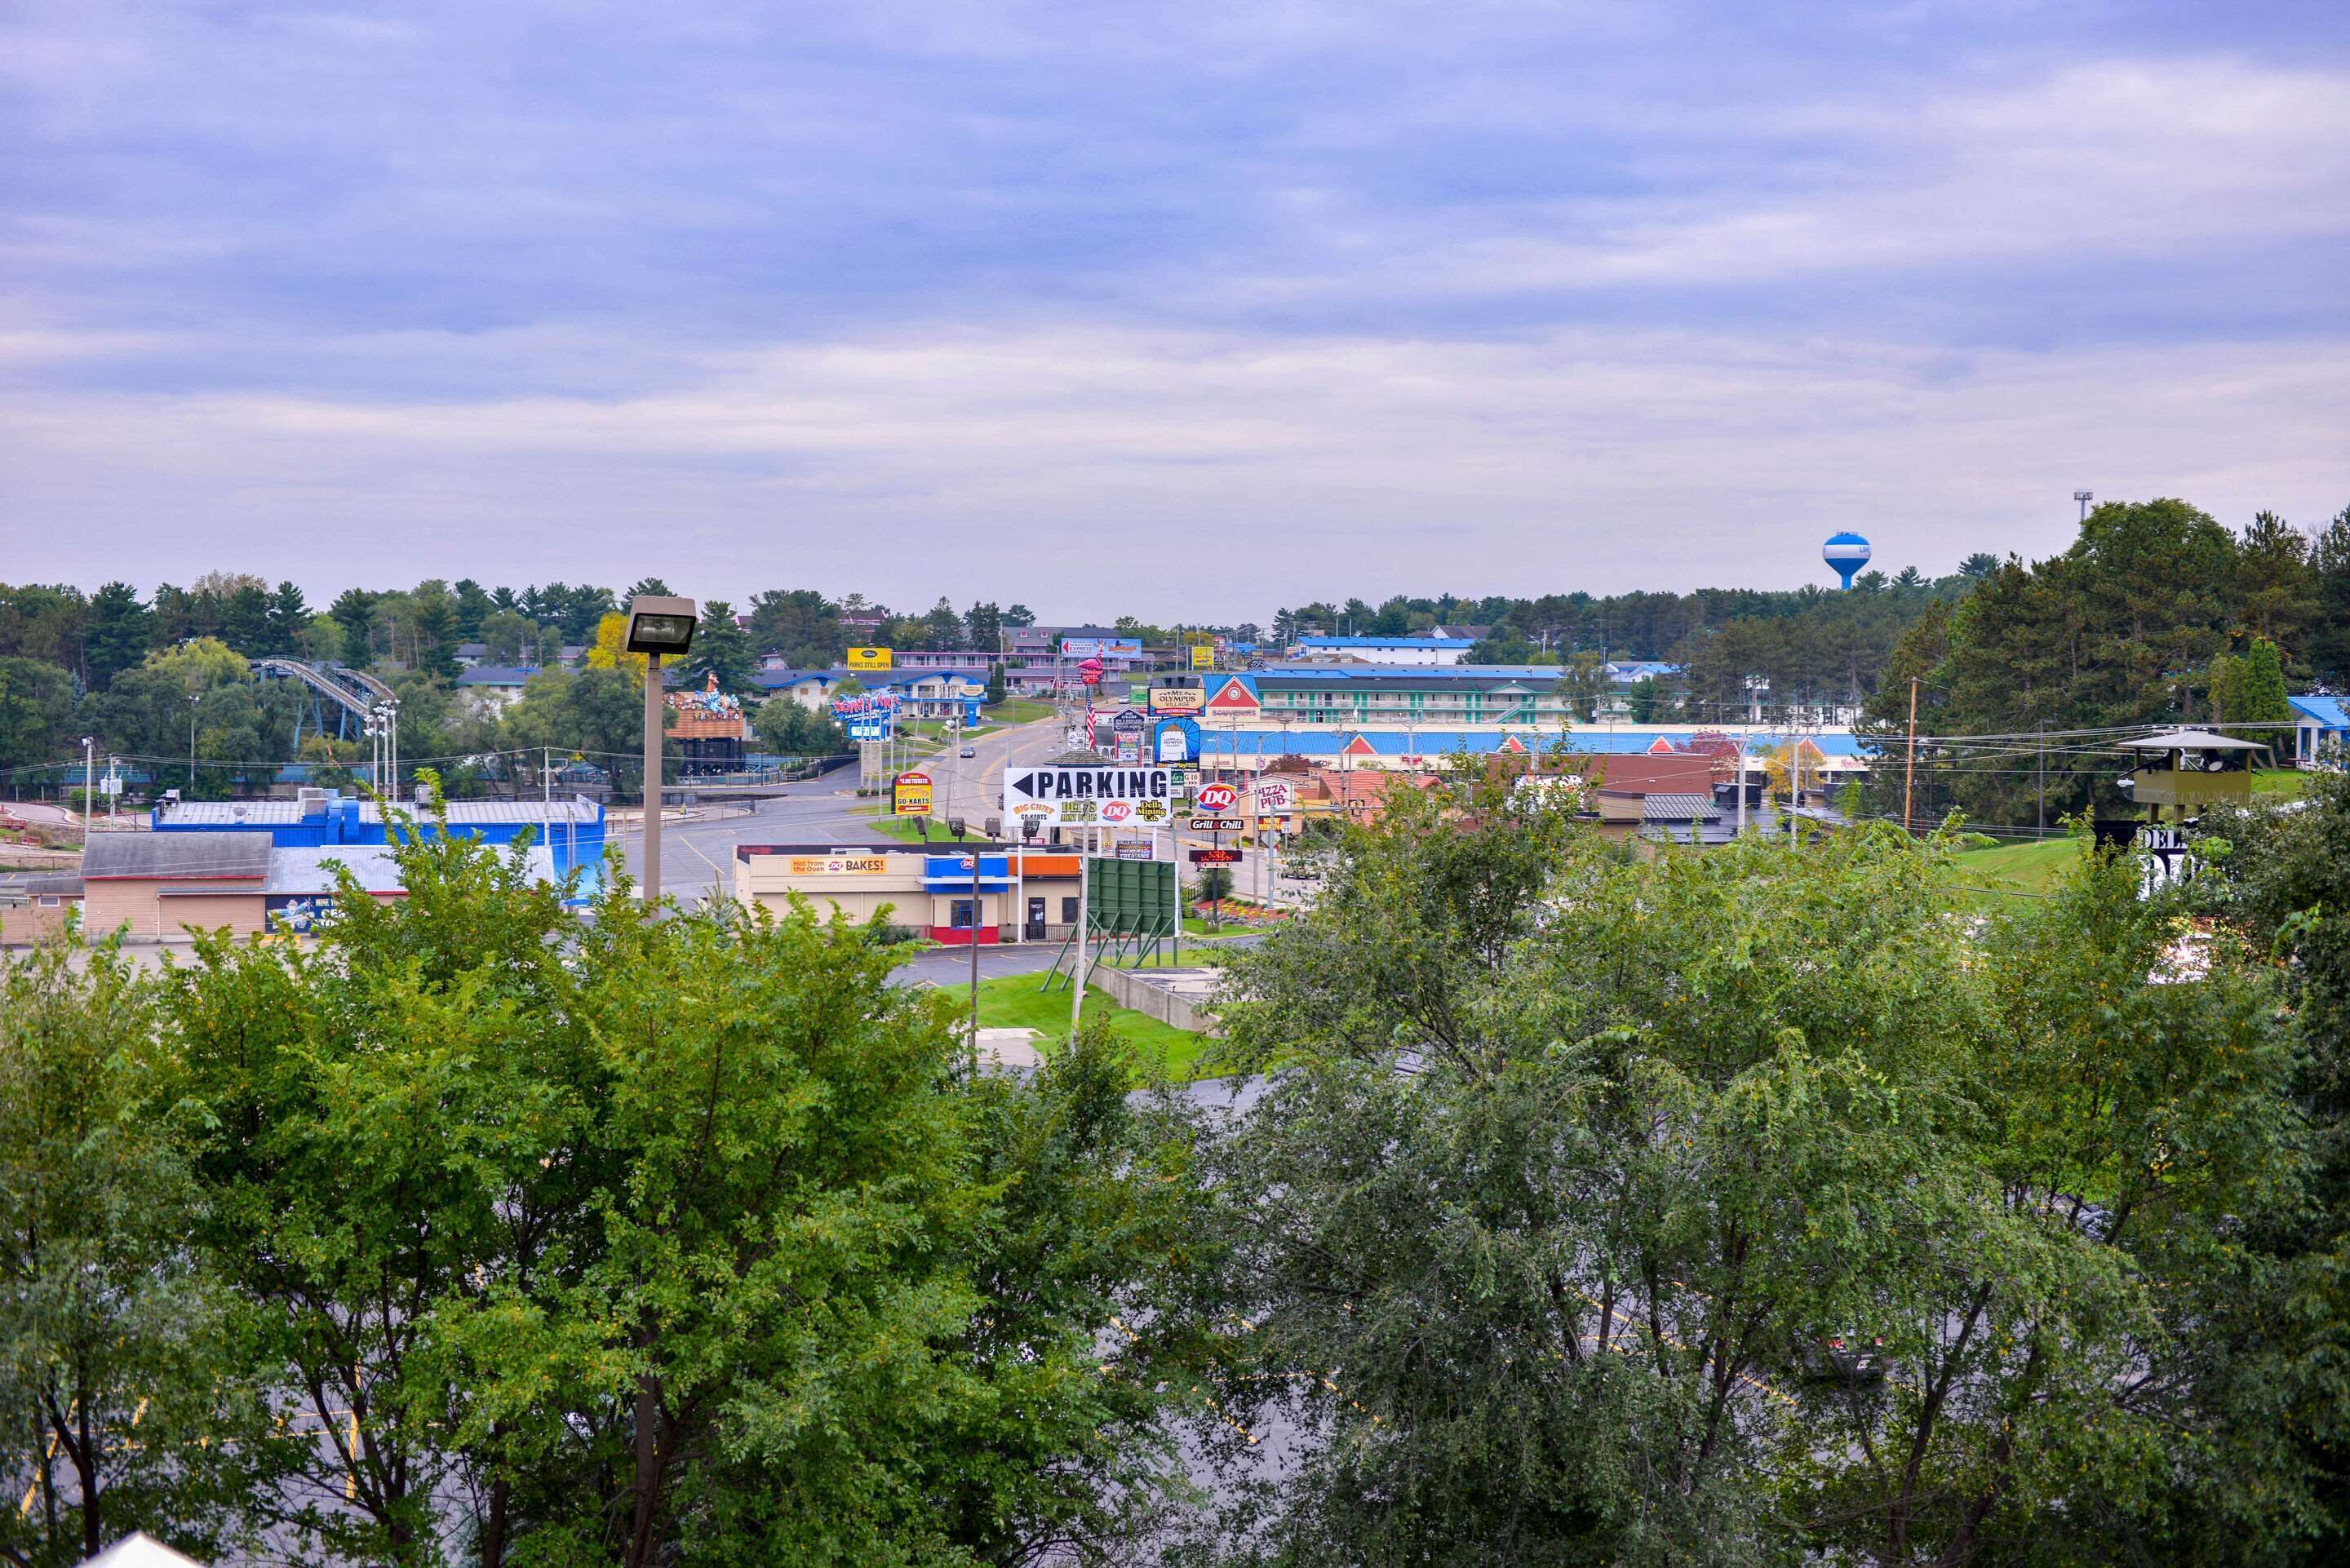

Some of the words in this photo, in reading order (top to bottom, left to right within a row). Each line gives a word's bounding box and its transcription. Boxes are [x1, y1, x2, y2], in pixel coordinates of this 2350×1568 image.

[835, 698, 871, 713] NOAHS
[1038, 771, 1167, 798] PARKING
[1204, 790, 1231, 805] DQ
[1260, 795, 1285, 808] PUB
[1013, 804, 1029, 814] BIG
[1030, 803, 1055, 814] CHIEF
[1141, 800, 1162, 808] Dells
[1106, 806, 1127, 817] DQ
[1136, 807, 1166, 817] Mining
[1061, 813, 1076, 822] ARMY
[1078, 813, 1097, 822] DUKS
[1192, 820, 1213, 828] Grill
[1220, 820, 1242, 828] Chill
[846, 860, 884, 870] BAKES!
[315, 898, 330, 906] MINE
